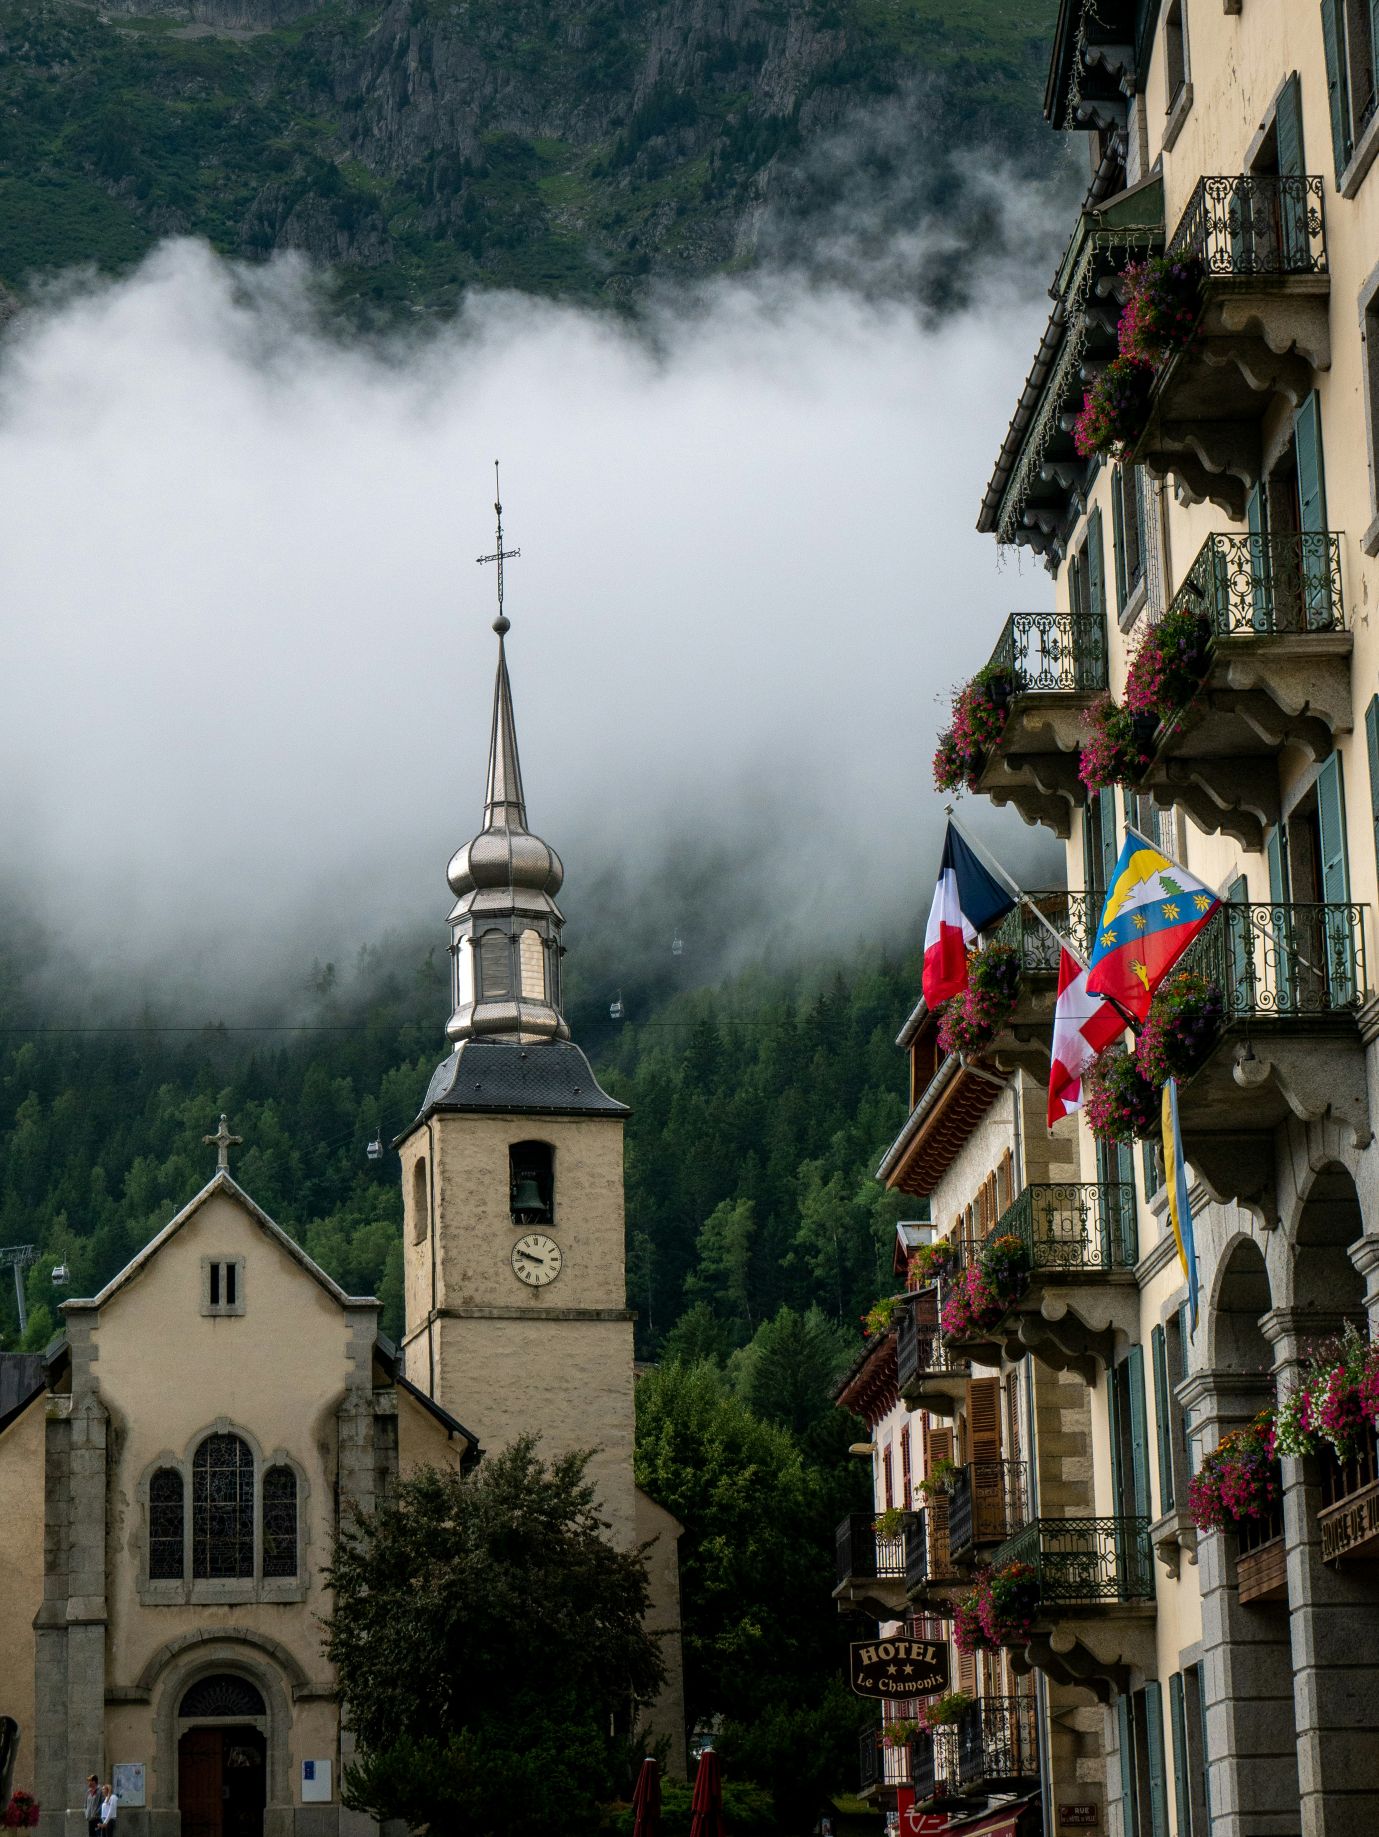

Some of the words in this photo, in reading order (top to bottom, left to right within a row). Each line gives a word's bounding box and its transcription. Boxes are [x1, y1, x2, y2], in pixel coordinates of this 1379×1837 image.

[859, 1642, 936, 1665] HOTEL
[857, 1673, 873, 1687] Le
[878, 1673, 944, 1692] Chamonix
[1074, 1807, 1090, 1815] RUE
